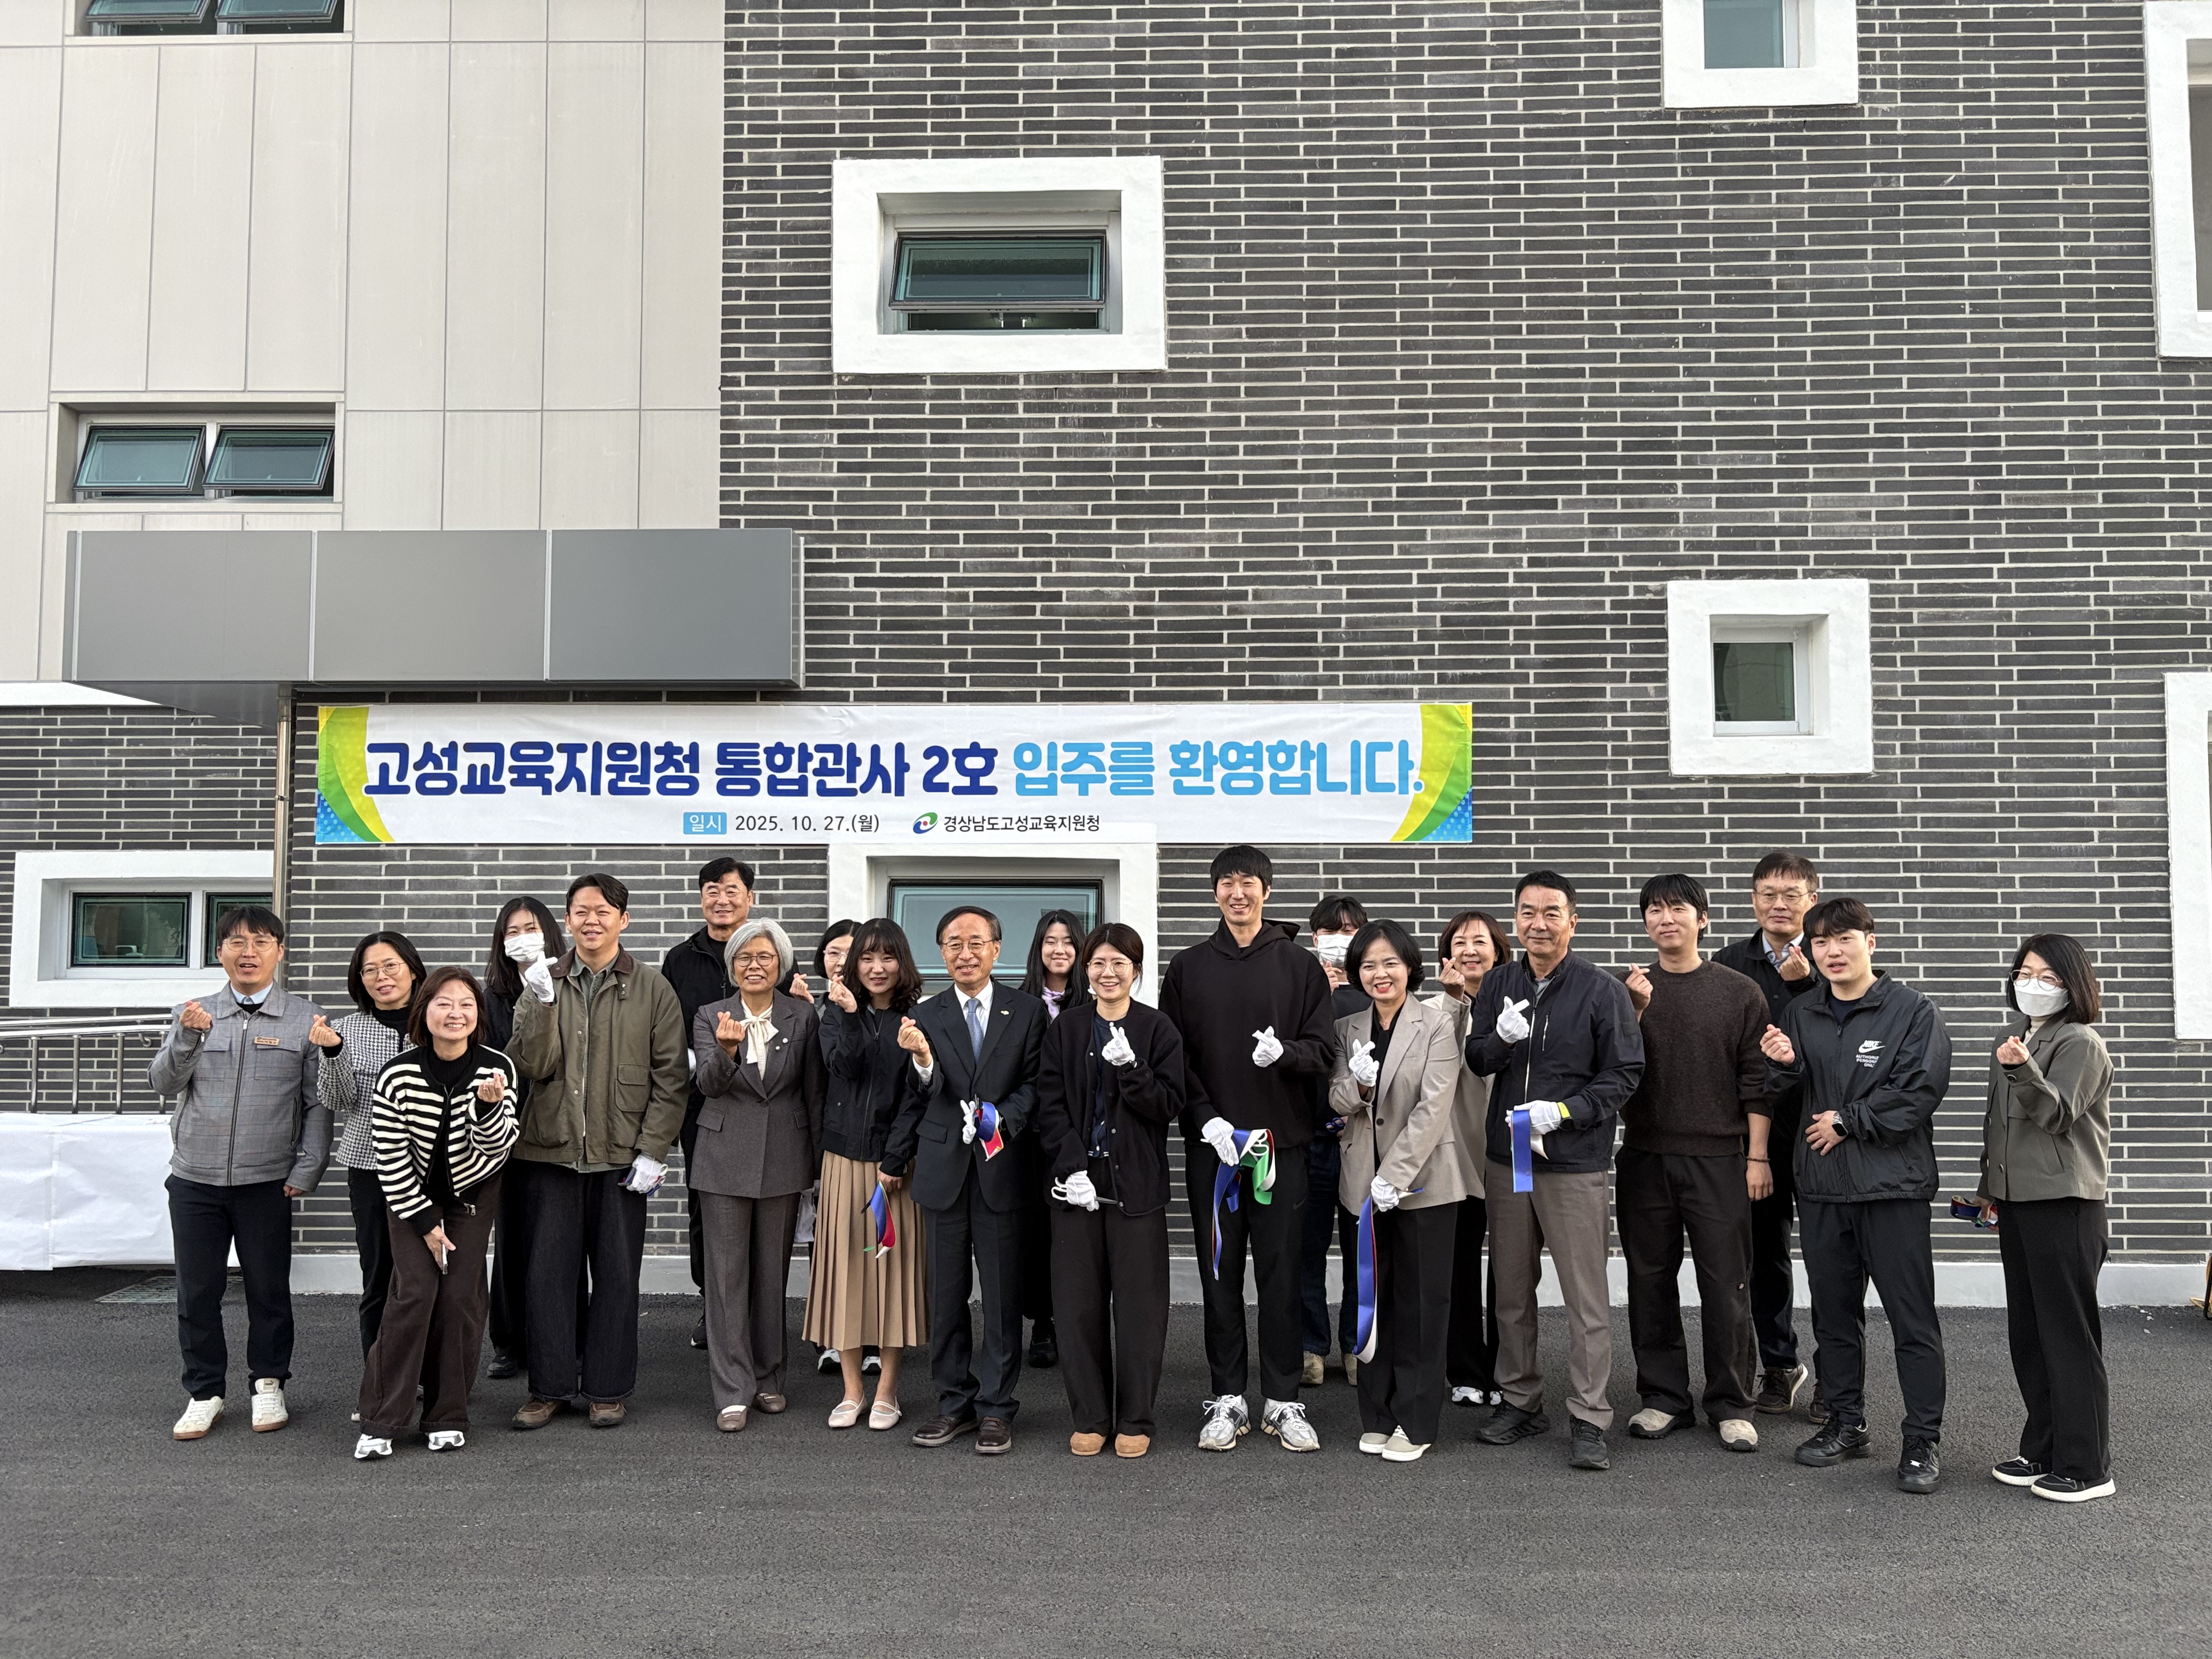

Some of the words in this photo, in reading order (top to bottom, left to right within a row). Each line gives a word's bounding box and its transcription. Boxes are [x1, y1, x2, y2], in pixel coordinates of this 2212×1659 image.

[364, 741, 701, 797] 고성교육지원청
[715, 742, 911, 798] 통합관사
[922, 741, 998, 796] 2호
[1013, 741, 1155, 797] 입주를
[1170, 739, 1423, 795] 환영합니다.
[689, 815, 723, 833] 일시
[735, 816, 783, 832] 2025.
[791, 816, 817, 832] 10.
[824, 814, 880, 833] 27.(월)
[944, 815, 1100, 832] 경상남도고성교육지원청
